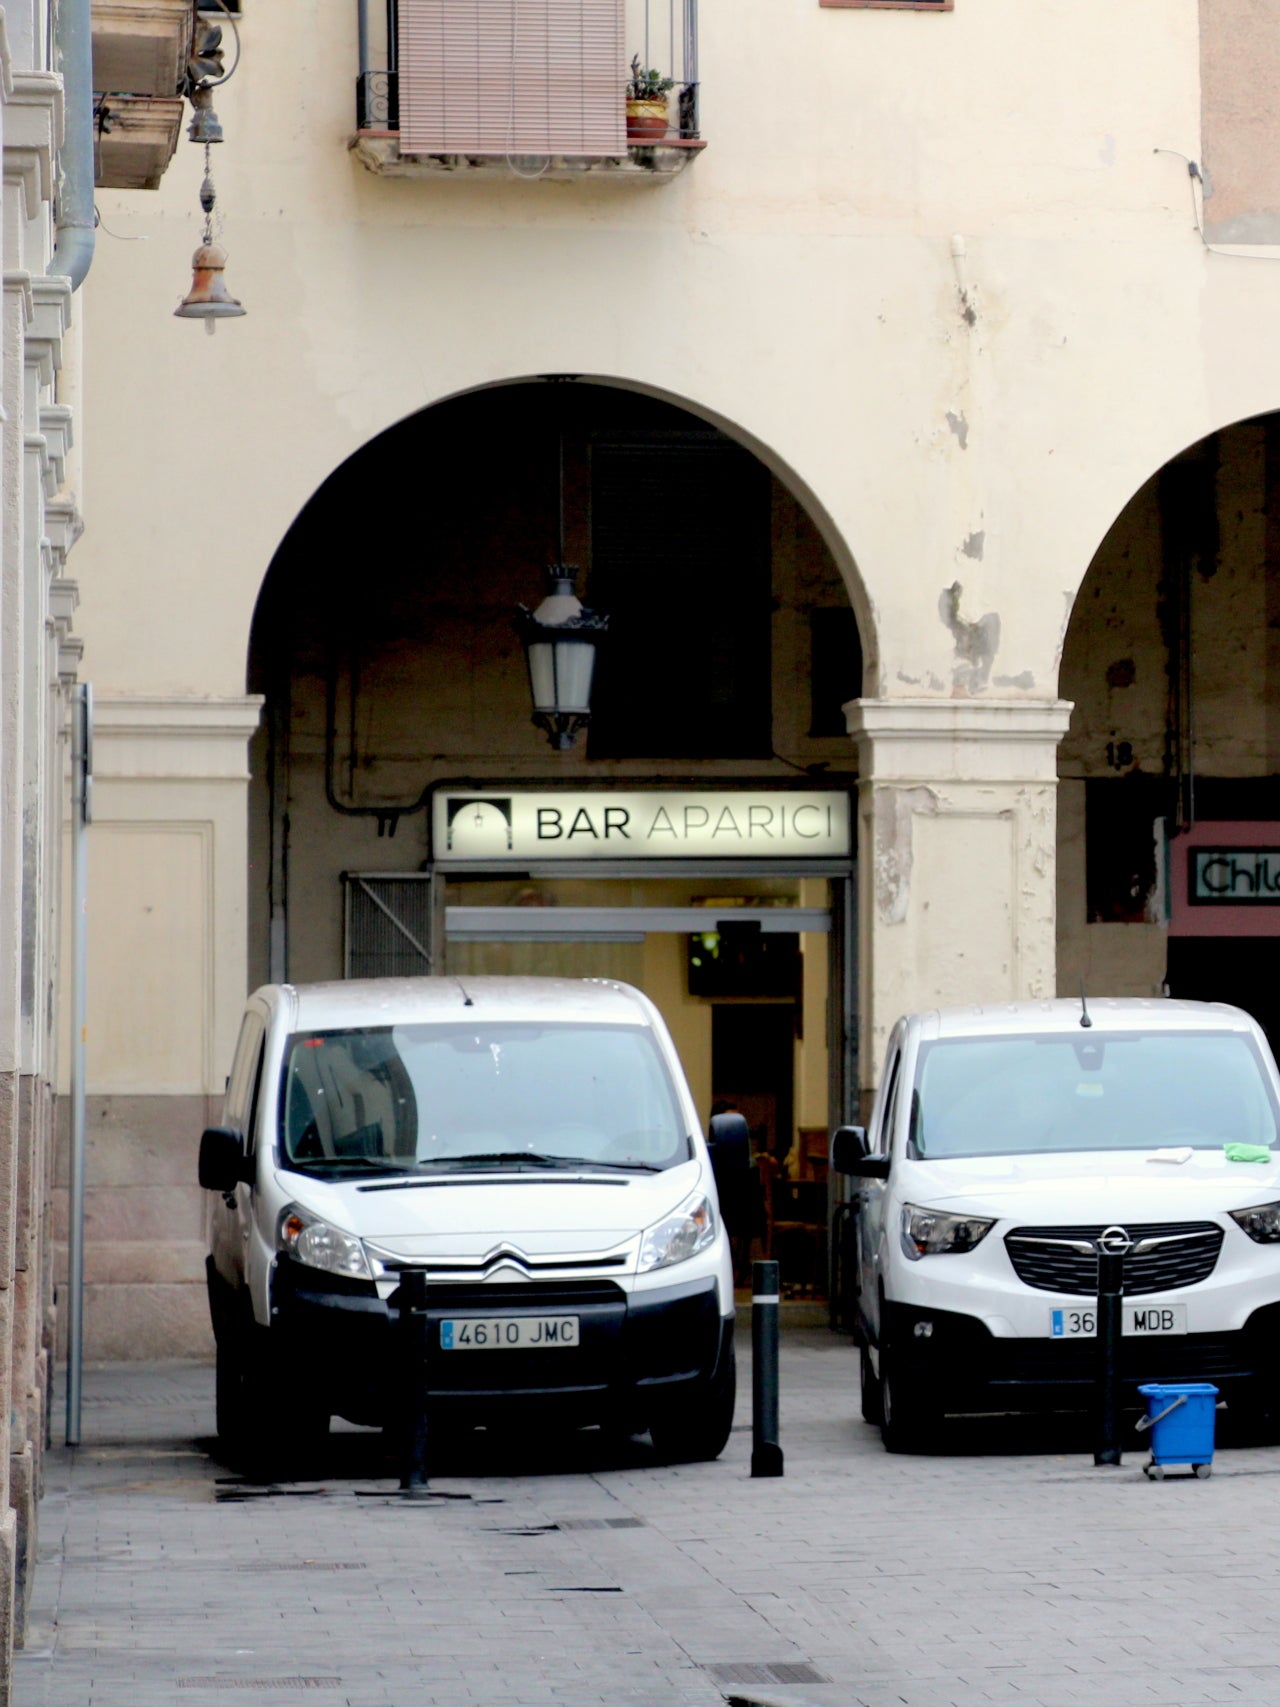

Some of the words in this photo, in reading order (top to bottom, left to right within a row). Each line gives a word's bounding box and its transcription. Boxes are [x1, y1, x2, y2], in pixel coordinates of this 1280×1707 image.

[536, 807, 631, 840] BAR
[647, 804, 833, 839] APARICI
[458, 1322, 520, 1344] 4610
[529, 1321, 574, 1343] JMC
[1069, 1312, 1096, 1333] 36
[1133, 1309, 1175, 1332] MDB
